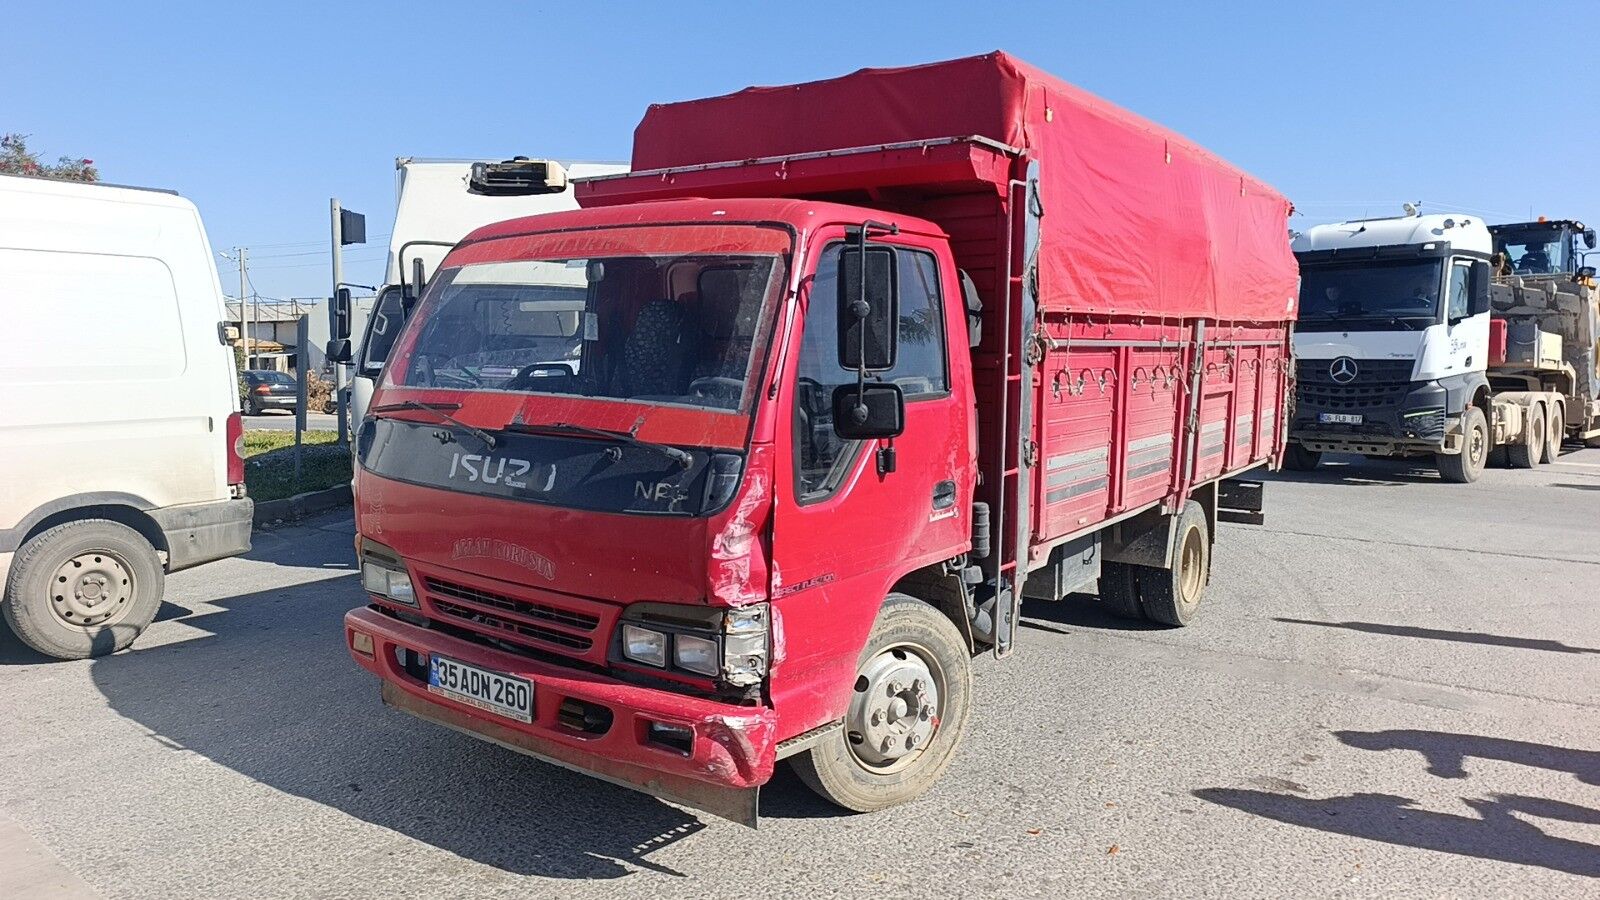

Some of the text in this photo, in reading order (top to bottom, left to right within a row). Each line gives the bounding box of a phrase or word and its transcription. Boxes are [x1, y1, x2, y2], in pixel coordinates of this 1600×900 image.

[438, 661, 458, 689] 35
[460, 668, 491, 700] ADN
[494, 678, 527, 711] 260
